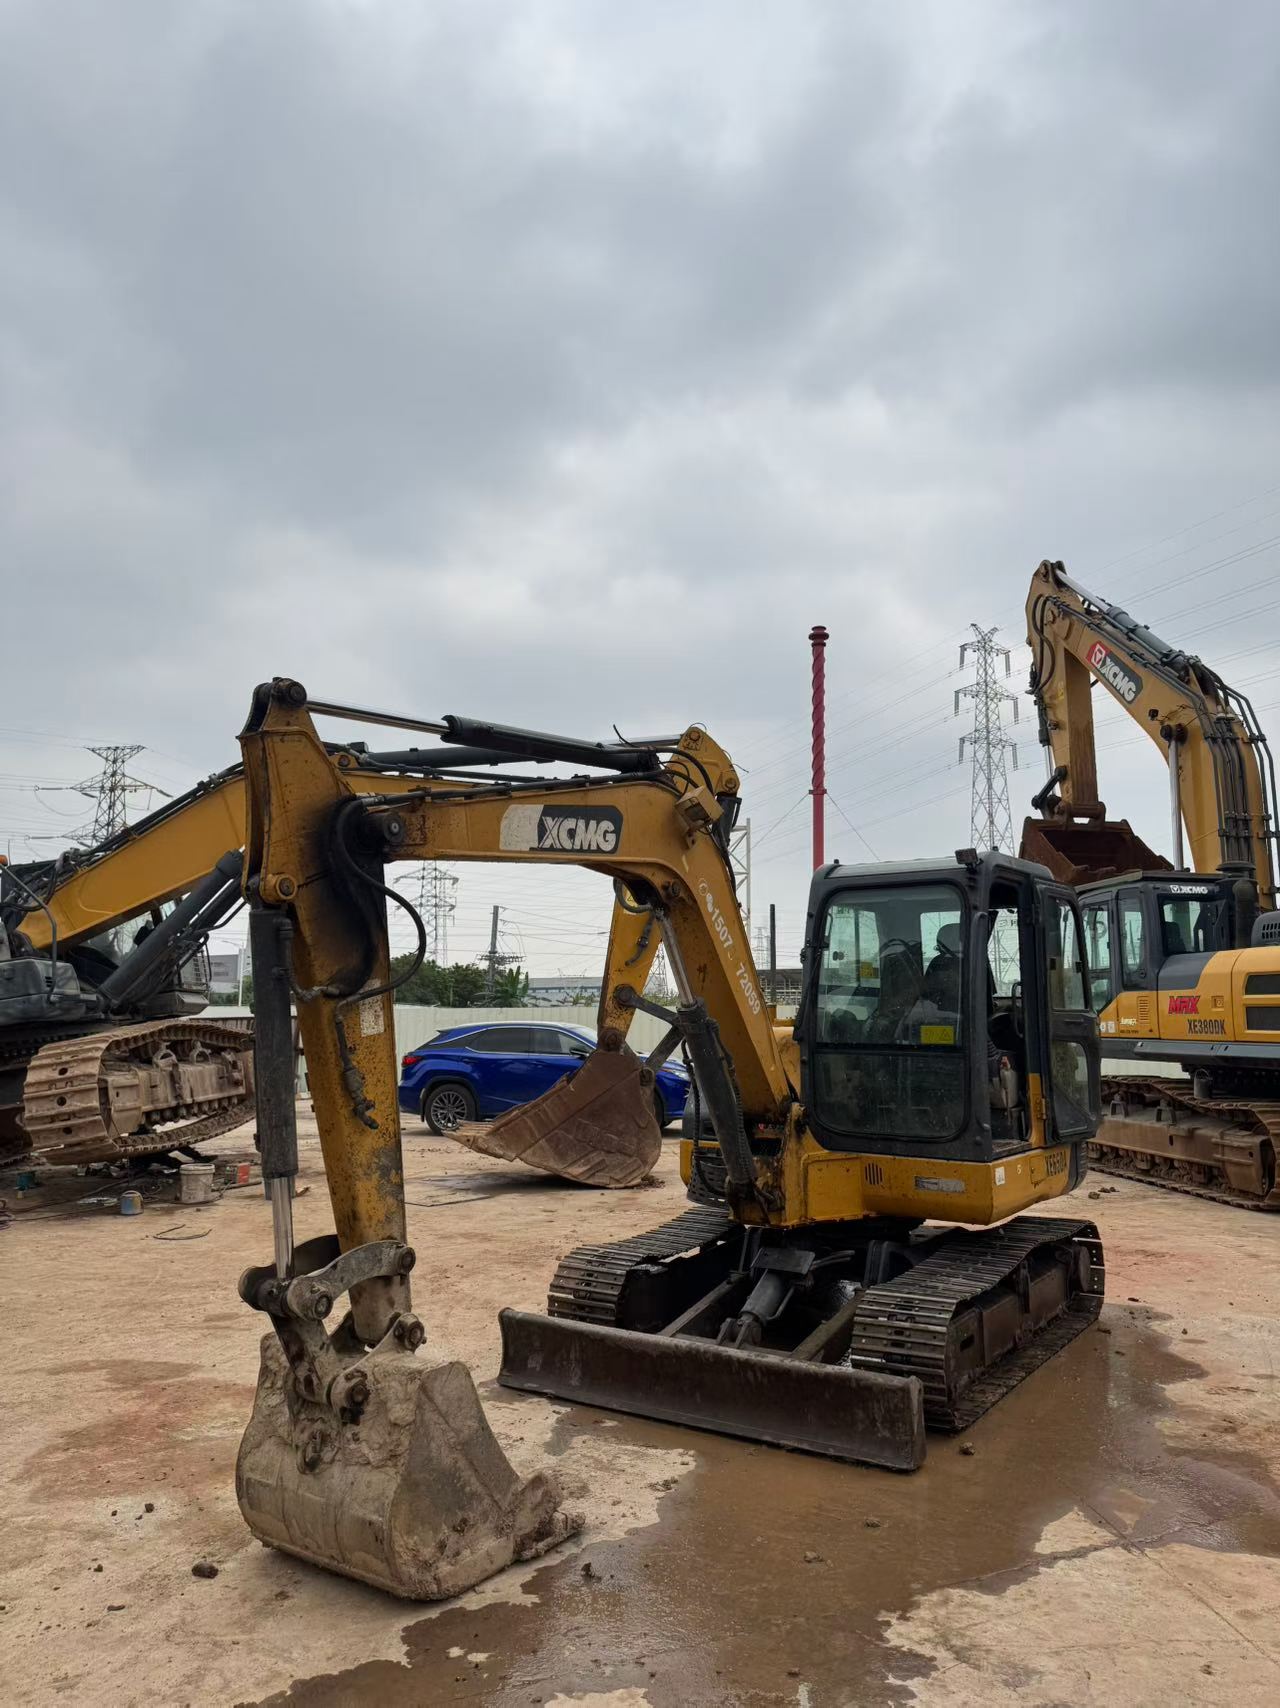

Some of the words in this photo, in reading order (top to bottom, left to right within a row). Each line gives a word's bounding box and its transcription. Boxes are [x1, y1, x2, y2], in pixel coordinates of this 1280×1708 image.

[1099, 656, 1136, 701] XCMG
[538, 816, 617, 852] XCMG
[1180, 885, 1208, 894] XCMG
[1187, 1018, 1226, 1035] XE380DK
